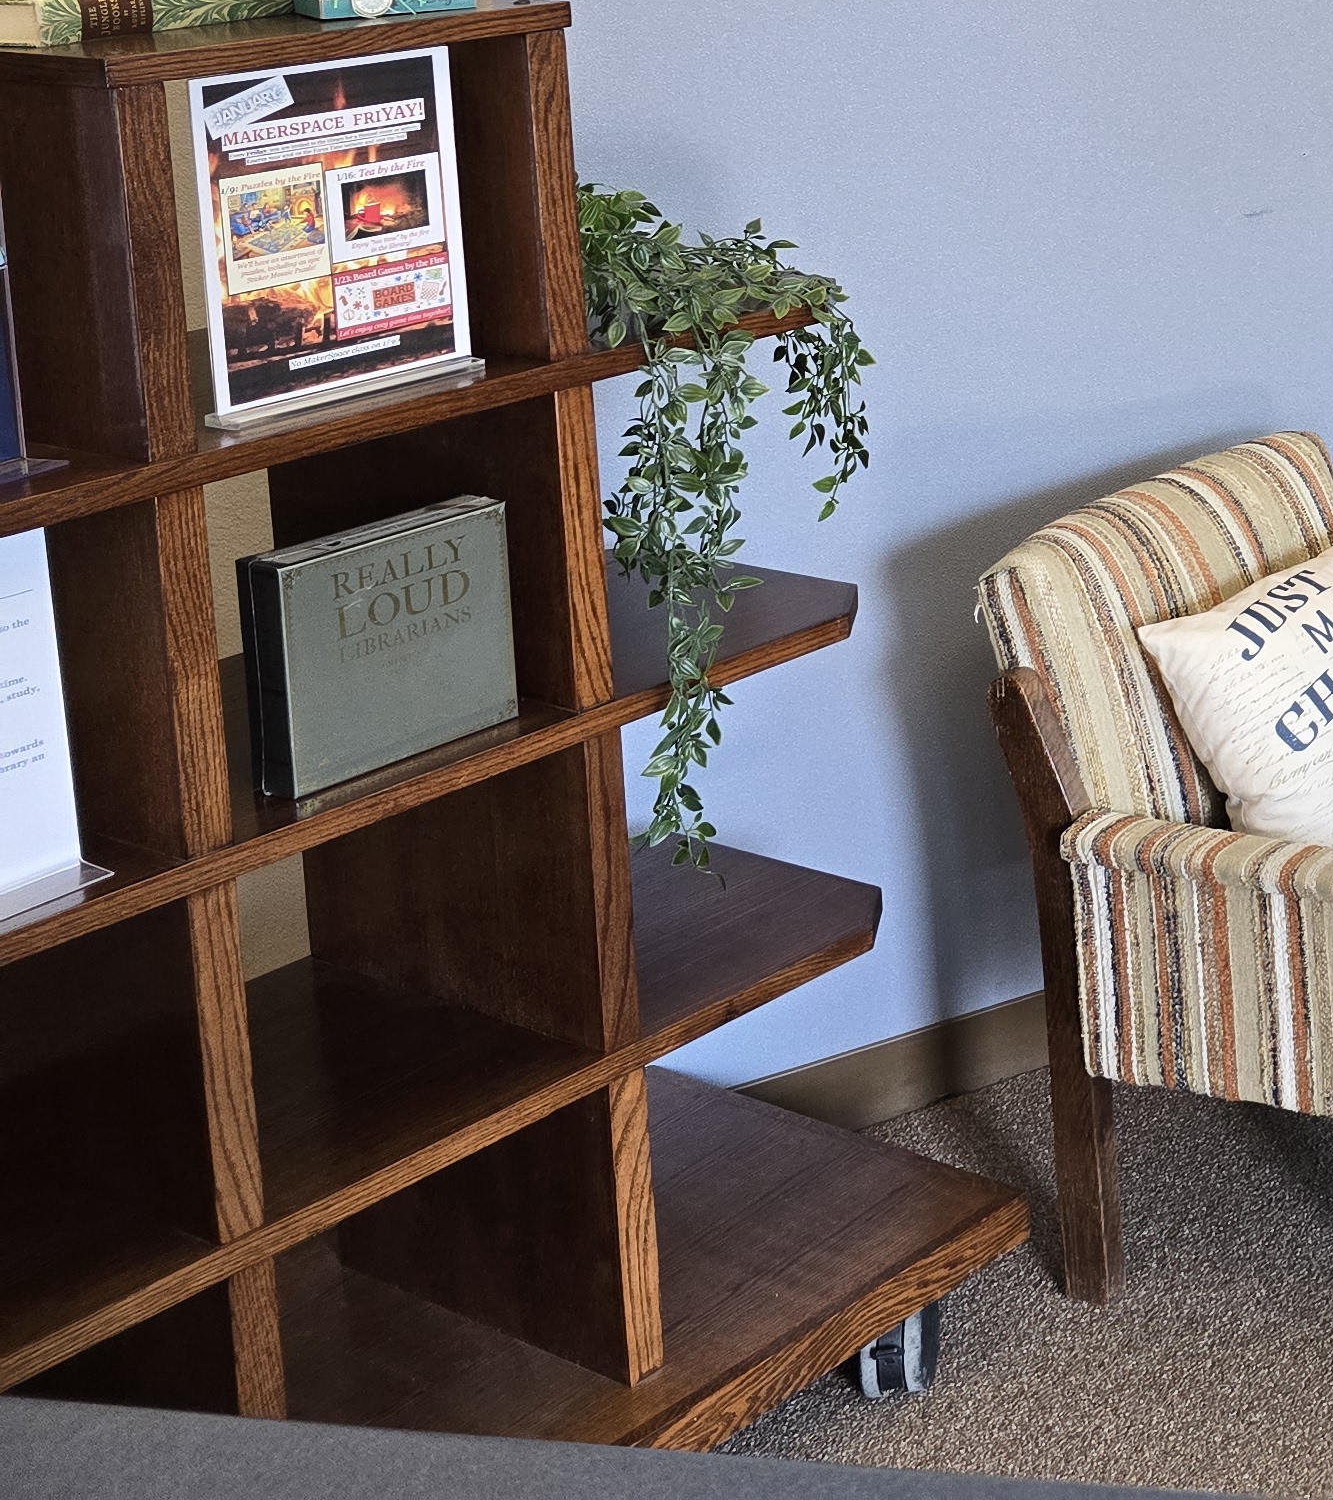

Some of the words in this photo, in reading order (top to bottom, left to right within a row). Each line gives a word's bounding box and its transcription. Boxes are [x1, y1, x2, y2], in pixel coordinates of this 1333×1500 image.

[88, 6, 99, 29] THE
[212, 89, 279, 127] JANUARY
[223, 116, 345, 147] MAKERSPACE
[353, 101, 424, 127] FRIYAY!
[359, 168, 375, 178] Tea
[377, 165, 388, 174] by
[390, 163, 403, 172] the
[406, 160, 425, 169] Fire
[221, 185, 239, 195] 1/9:
[240, 178, 272, 192] Puzzles
[275, 177, 286, 187] by
[288, 174, 301, 183] the
[303, 172, 320, 180] Fire
[353, 269, 377, 281] Board
[377, 265, 404, 277] Games
[405, 262, 415, 271] by
[415, 259, 428, 268] the
[429, 256, 446, 265] Fire
[374, 283, 414, 299] BOARD
[374, 292, 415, 309] GAMES
[291, 360, 301, 368] No
[351, 344, 370, 355] class
[371, 342, 381, 350] on
[331, 535, 467, 601] REALLY
[335, 569, 471, 641] LOUD
[1226, 568, 1331, 662] JUST
[12, 618, 30, 630] the
[339, 606, 472, 664] LIBRARIANS
[6, 685, 41, 702] study,
[31, 753, 45, 763] an
